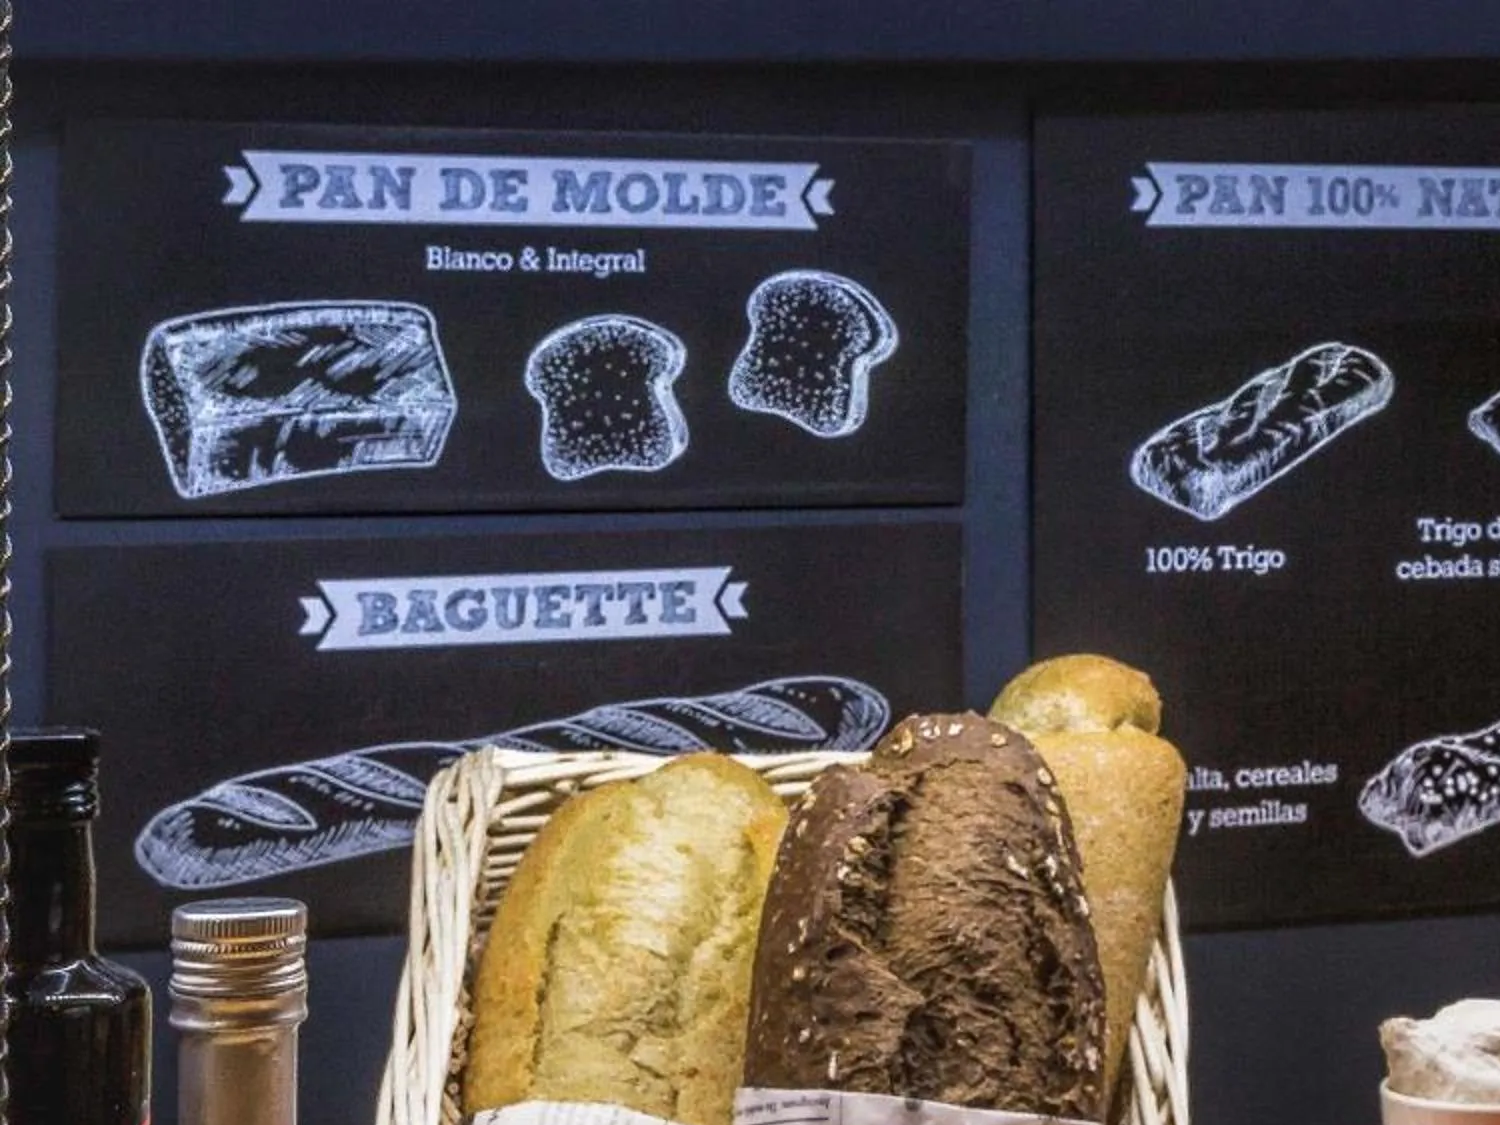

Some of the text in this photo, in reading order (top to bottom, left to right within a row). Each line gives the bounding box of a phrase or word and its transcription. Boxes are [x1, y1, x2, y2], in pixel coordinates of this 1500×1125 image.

[278, 163, 787, 217] PAN DE MOLDE
[1175, 173, 1289, 215] PAN
[1306, 175, 1399, 217] 100%
[425, 245, 645, 279] Blanco & Integral
[1417, 517, 1482, 547] Trigo
[1145, 544, 1286, 575] 100% Trigo
[1396, 553, 1484, 580] cebada
[356, 580, 697, 637] BAGUETTE
[1235, 760, 1339, 788] cereales
[1187, 800, 1308, 836] y semillas
